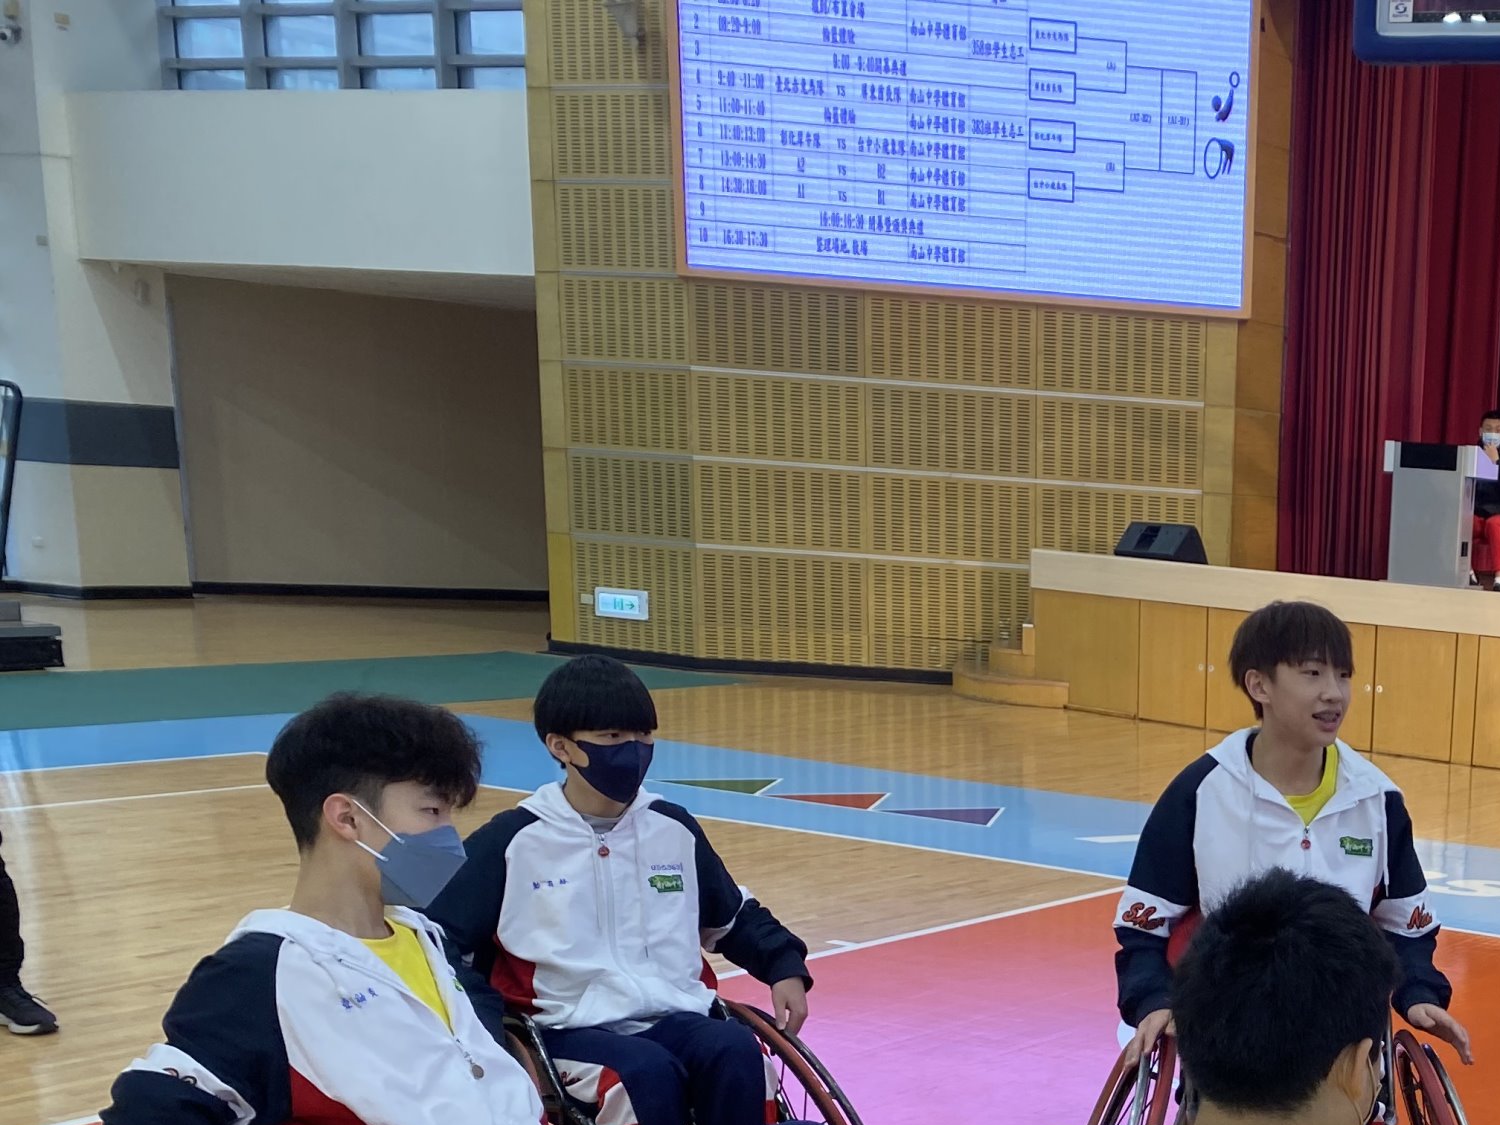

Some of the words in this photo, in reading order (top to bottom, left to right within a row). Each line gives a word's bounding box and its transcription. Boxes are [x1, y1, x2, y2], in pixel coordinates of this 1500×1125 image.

[693, 13, 699, 30] 2
[694, 40, 700, 57] 3
[698, 147, 703, 164] 7
[700, 201, 705, 216] 9
[699, 227, 708, 242] 10
